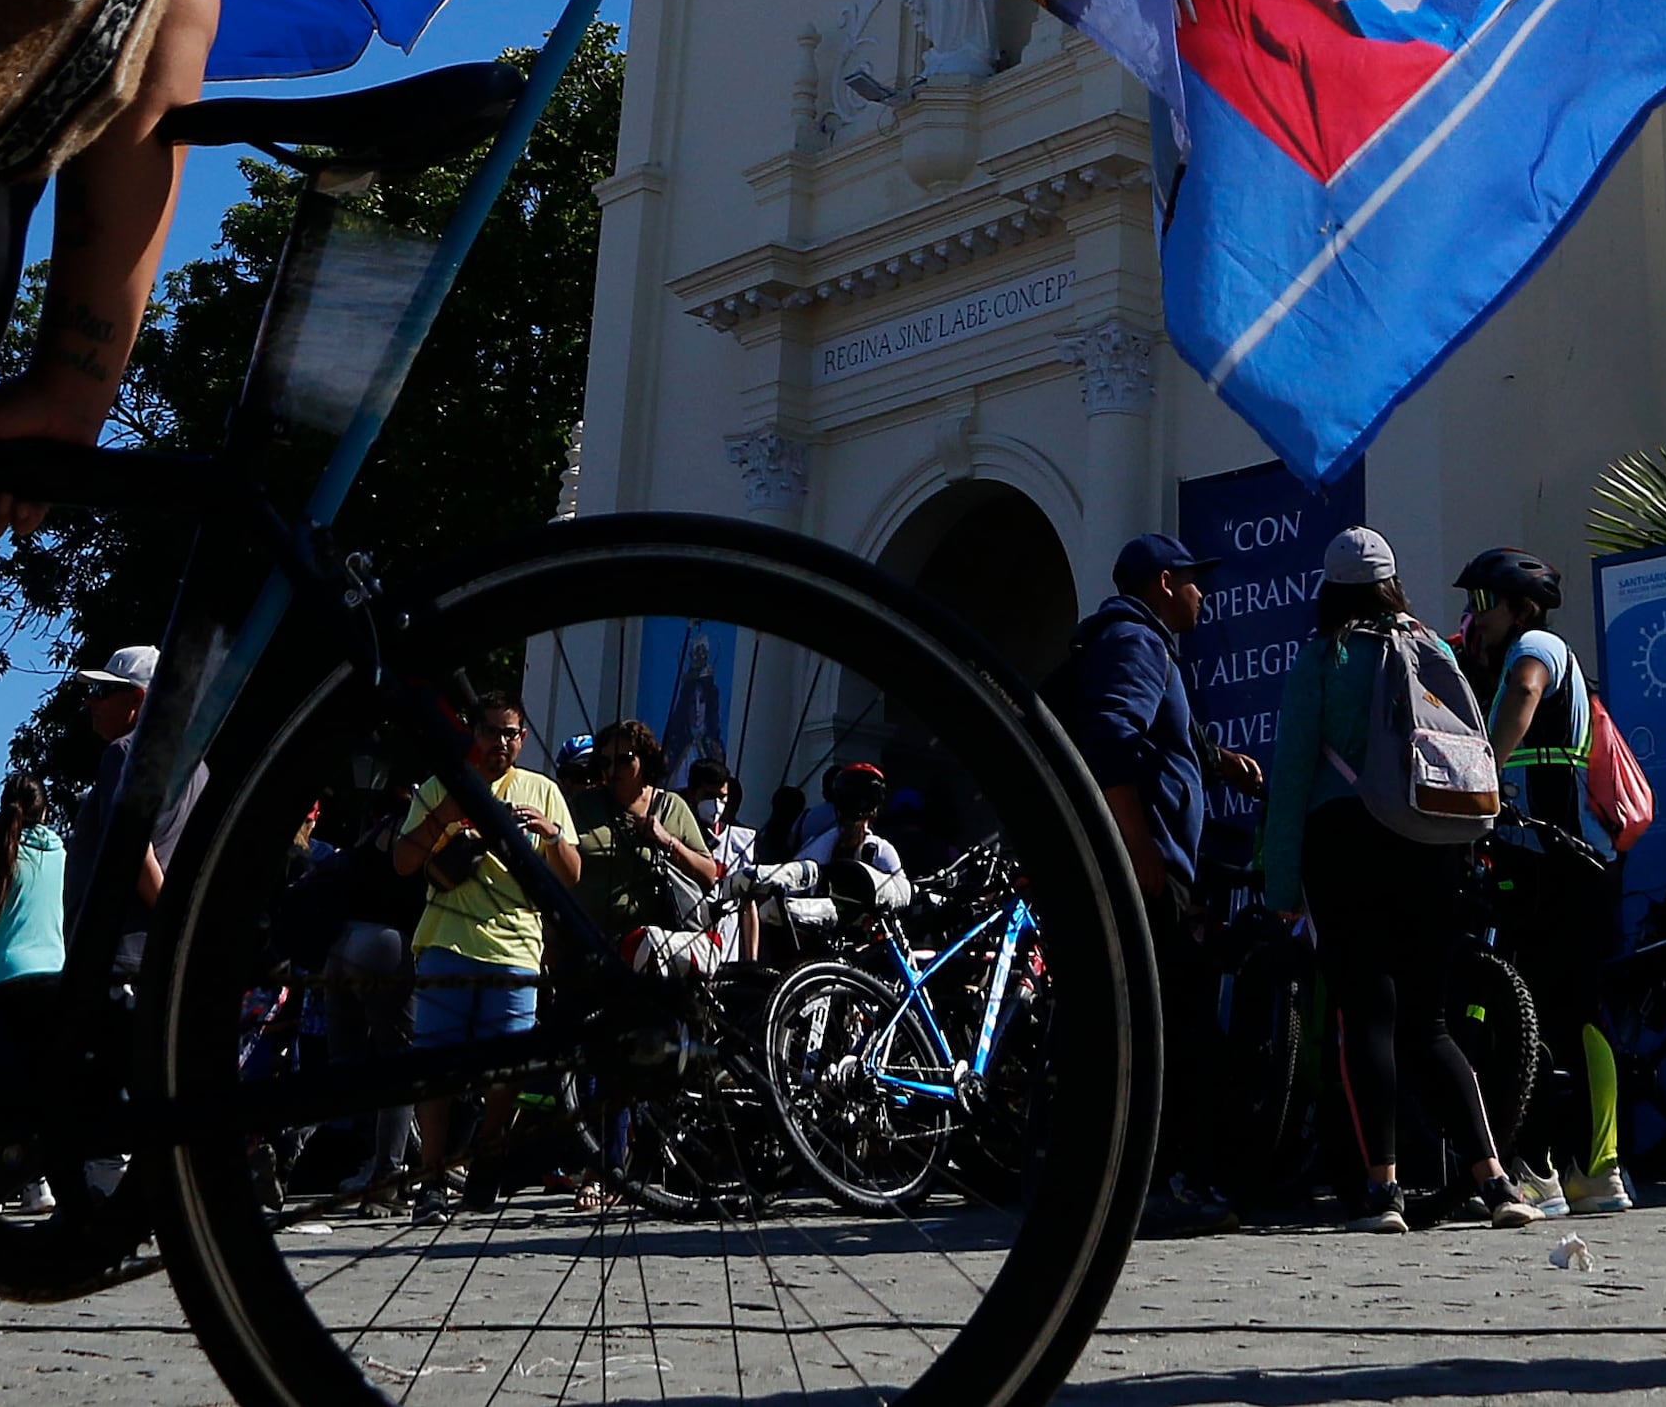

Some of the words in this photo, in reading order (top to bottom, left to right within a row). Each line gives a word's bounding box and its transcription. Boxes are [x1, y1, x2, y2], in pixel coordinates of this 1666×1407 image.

[823, 333, 892, 375] REGINA
[895, 317, 934, 351] SINE
[1201, 568, 1326, 625] SPERANZ
[1190, 659, 1204, 691] Y
[1209, 639, 1307, 687] ALEGR
[1199, 708, 1281, 750] OLVE
